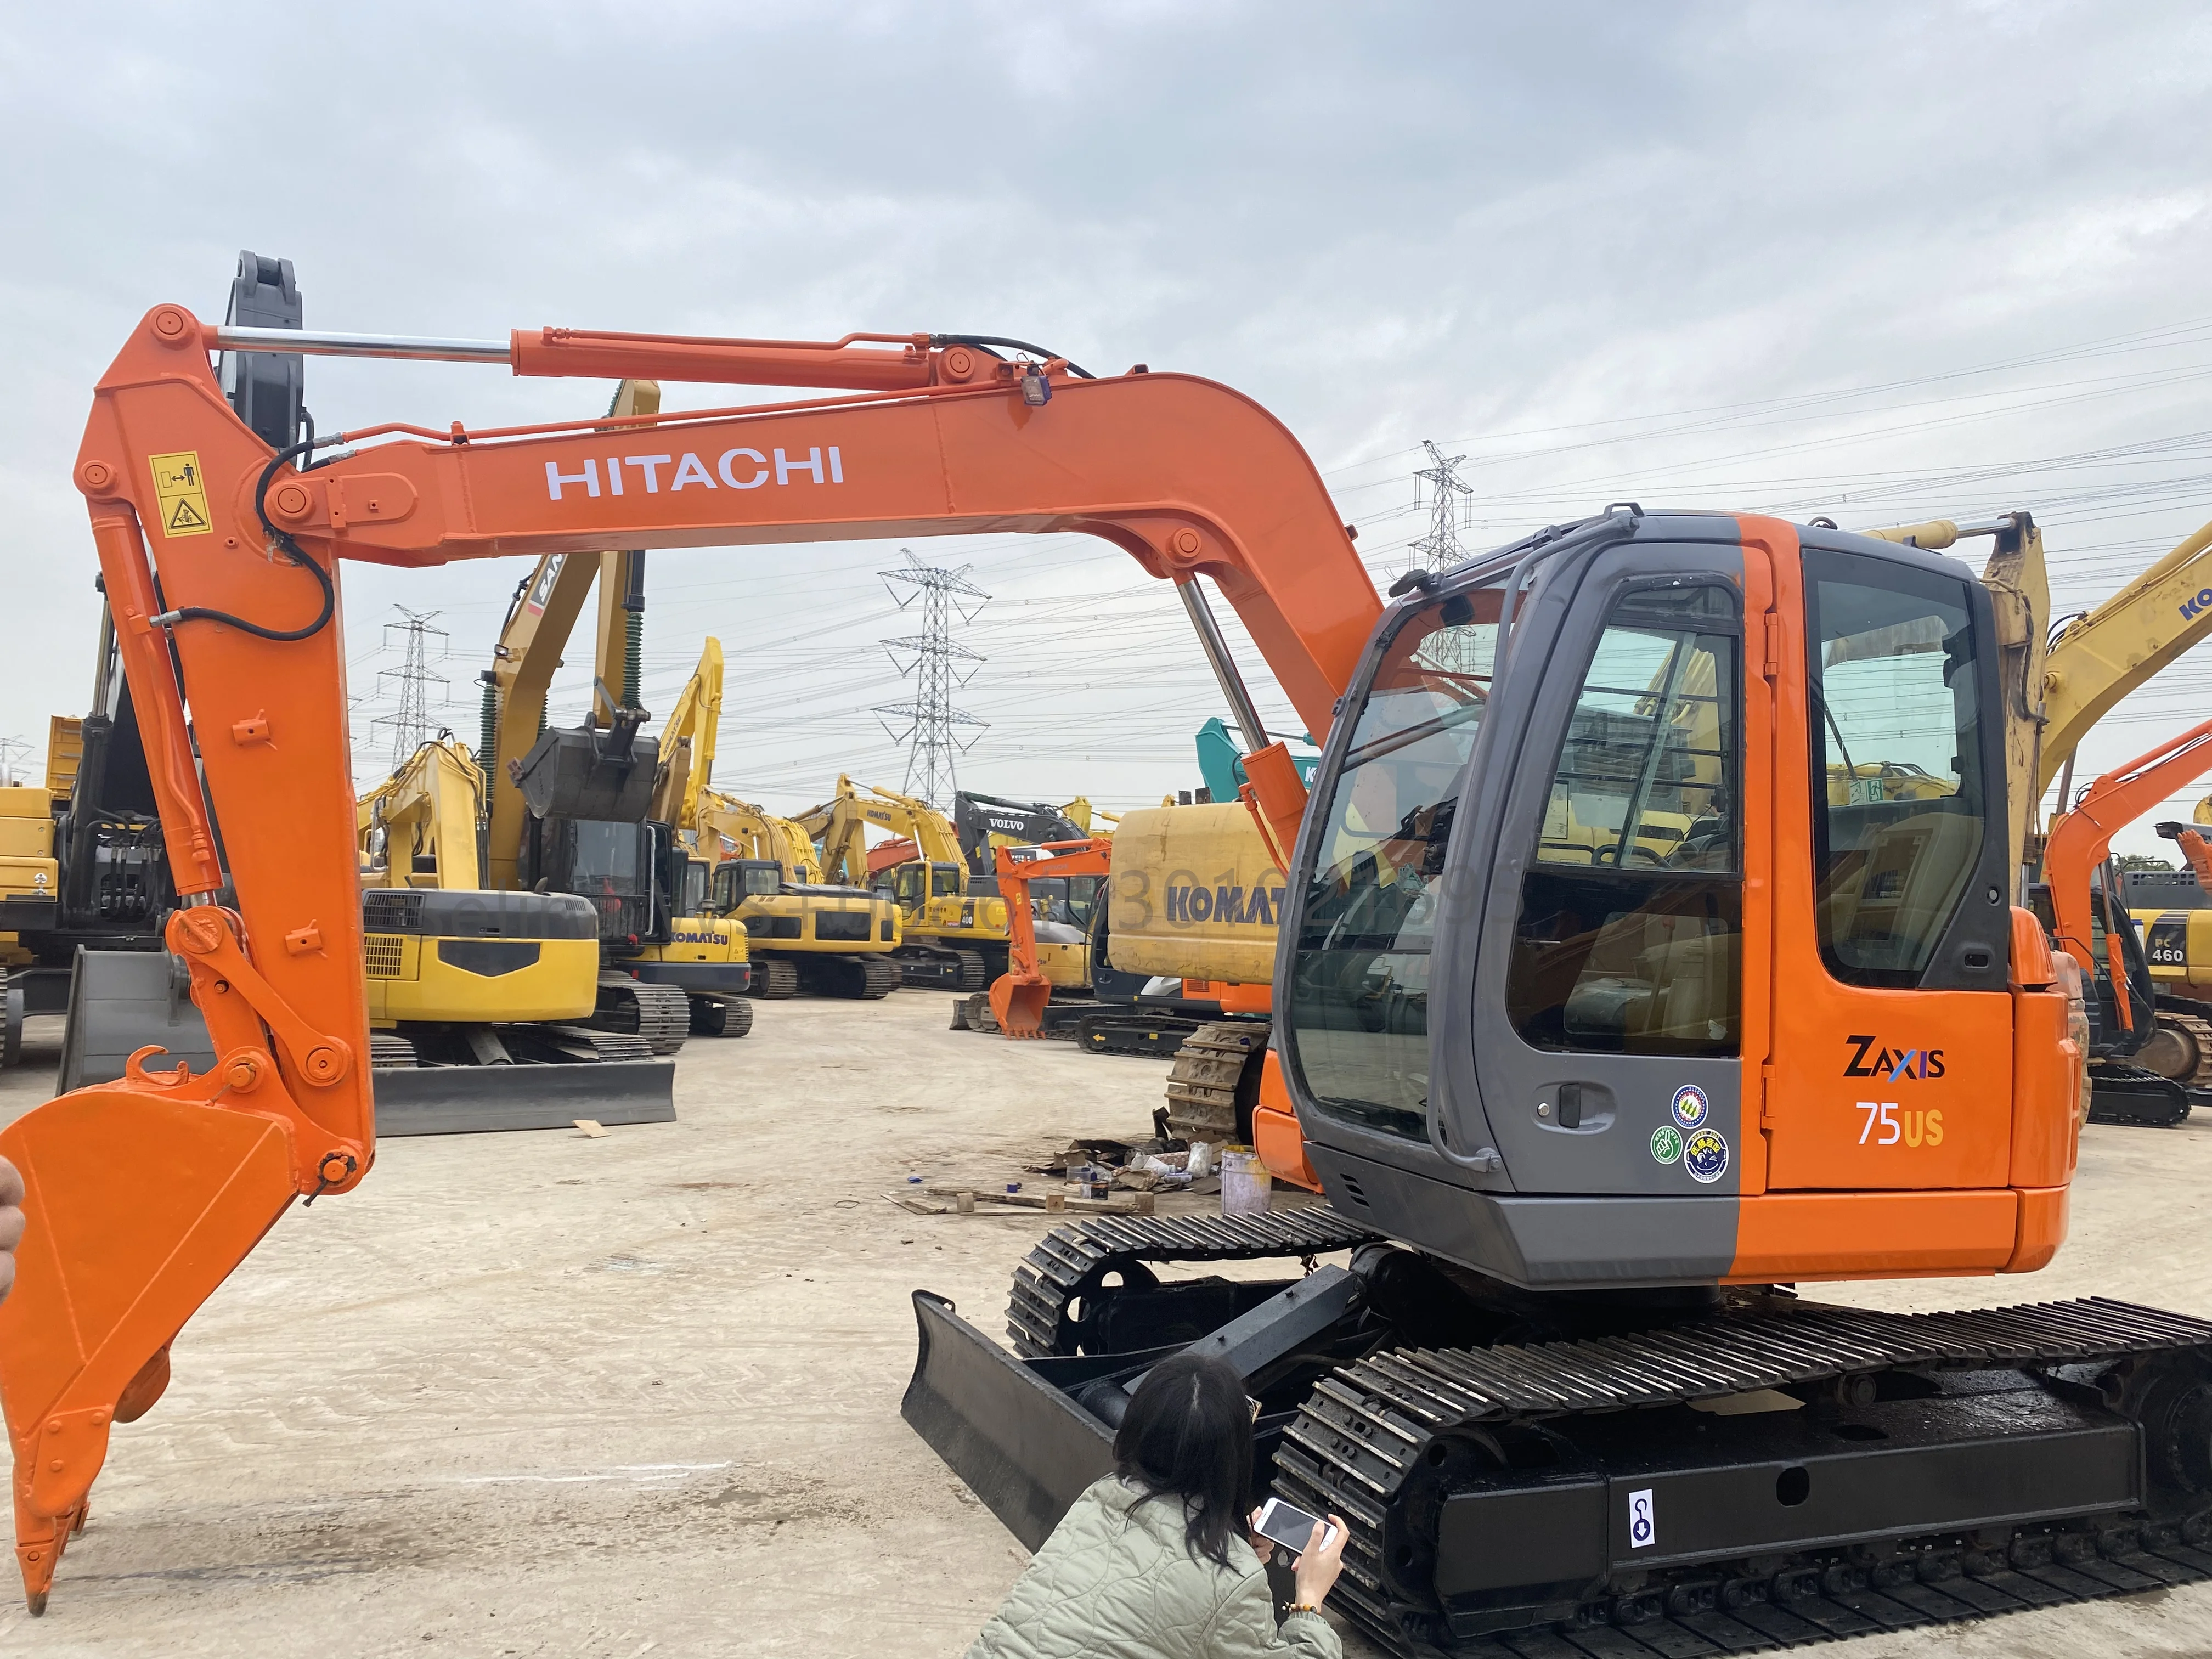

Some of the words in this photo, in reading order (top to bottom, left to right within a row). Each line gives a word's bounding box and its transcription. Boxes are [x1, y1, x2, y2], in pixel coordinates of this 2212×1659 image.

[545, 446, 843, 500] HITACHI
[2179, 588, 2212, 621] KO
[663, 714, 681, 757] KOMATSU
[1305, 766, 1317, 782] K
[867, 809, 891, 822] KOMATSU
[989, 818, 1024, 831] VOLVO
[962, 916, 973, 924] 400
[2155, 939, 2171, 947] PC
[2152, 949, 2183, 962] 460
